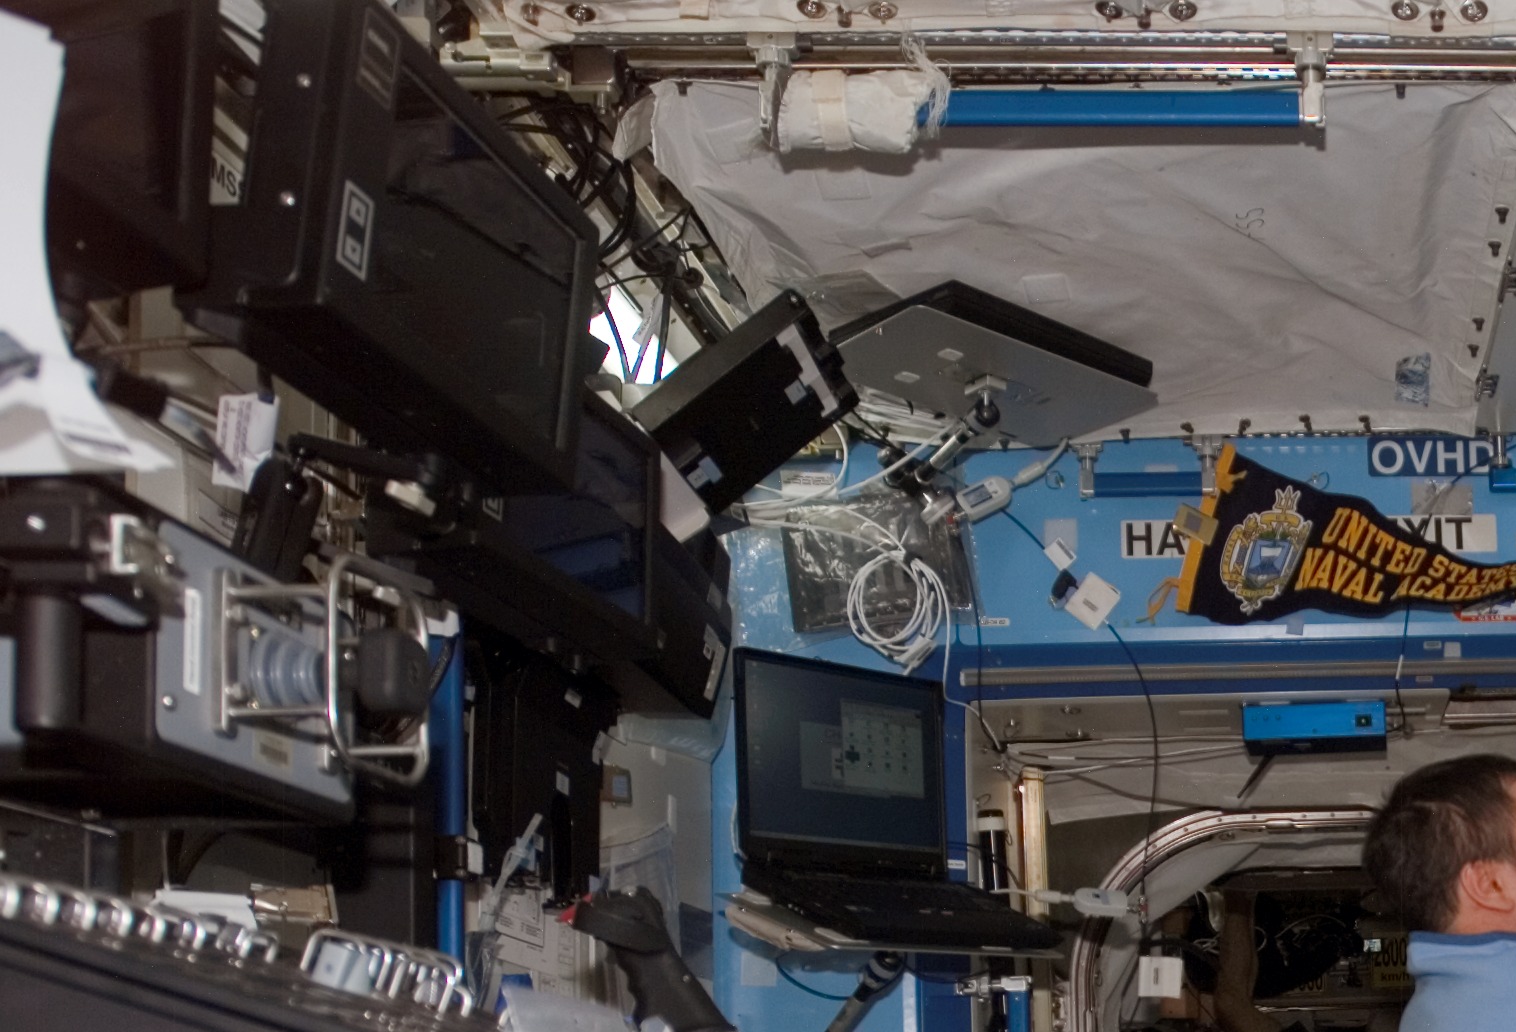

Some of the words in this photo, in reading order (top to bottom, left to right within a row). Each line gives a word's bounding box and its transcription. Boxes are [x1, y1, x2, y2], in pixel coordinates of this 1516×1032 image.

[211, 155, 240, 197] MS
[1371, 439, 1493, 474] OVHD
[1322, 506, 1427, 576] UNITED
[1396, 517, 1472, 550] XIT
[1295, 547, 1384, 604] NAVAL
